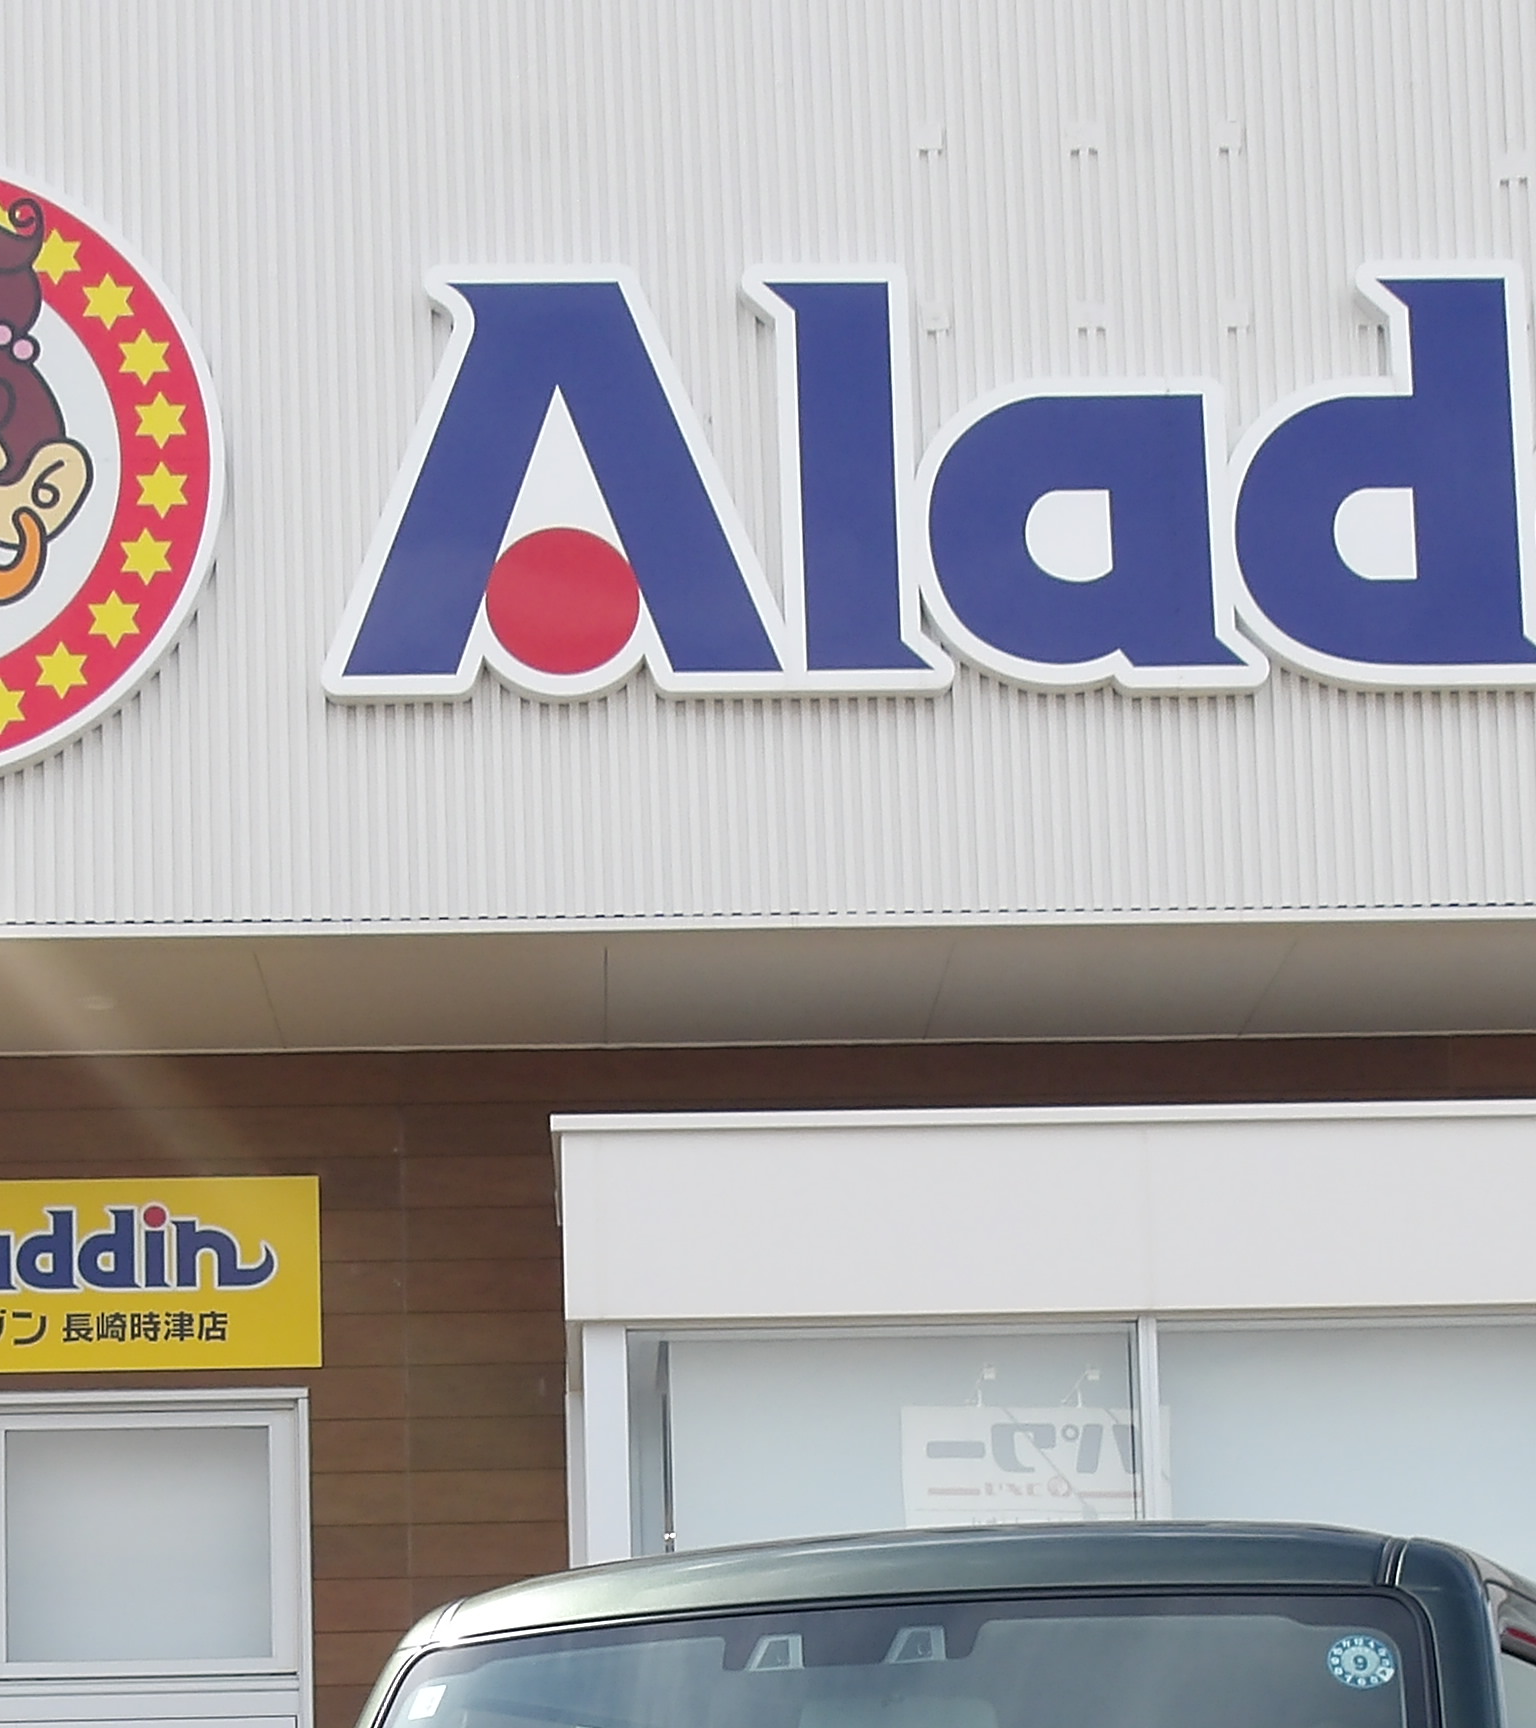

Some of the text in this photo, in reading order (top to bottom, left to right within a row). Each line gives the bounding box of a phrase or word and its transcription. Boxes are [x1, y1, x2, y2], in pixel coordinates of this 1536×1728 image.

[62, 1311, 229, 1343] 長崎時津店
